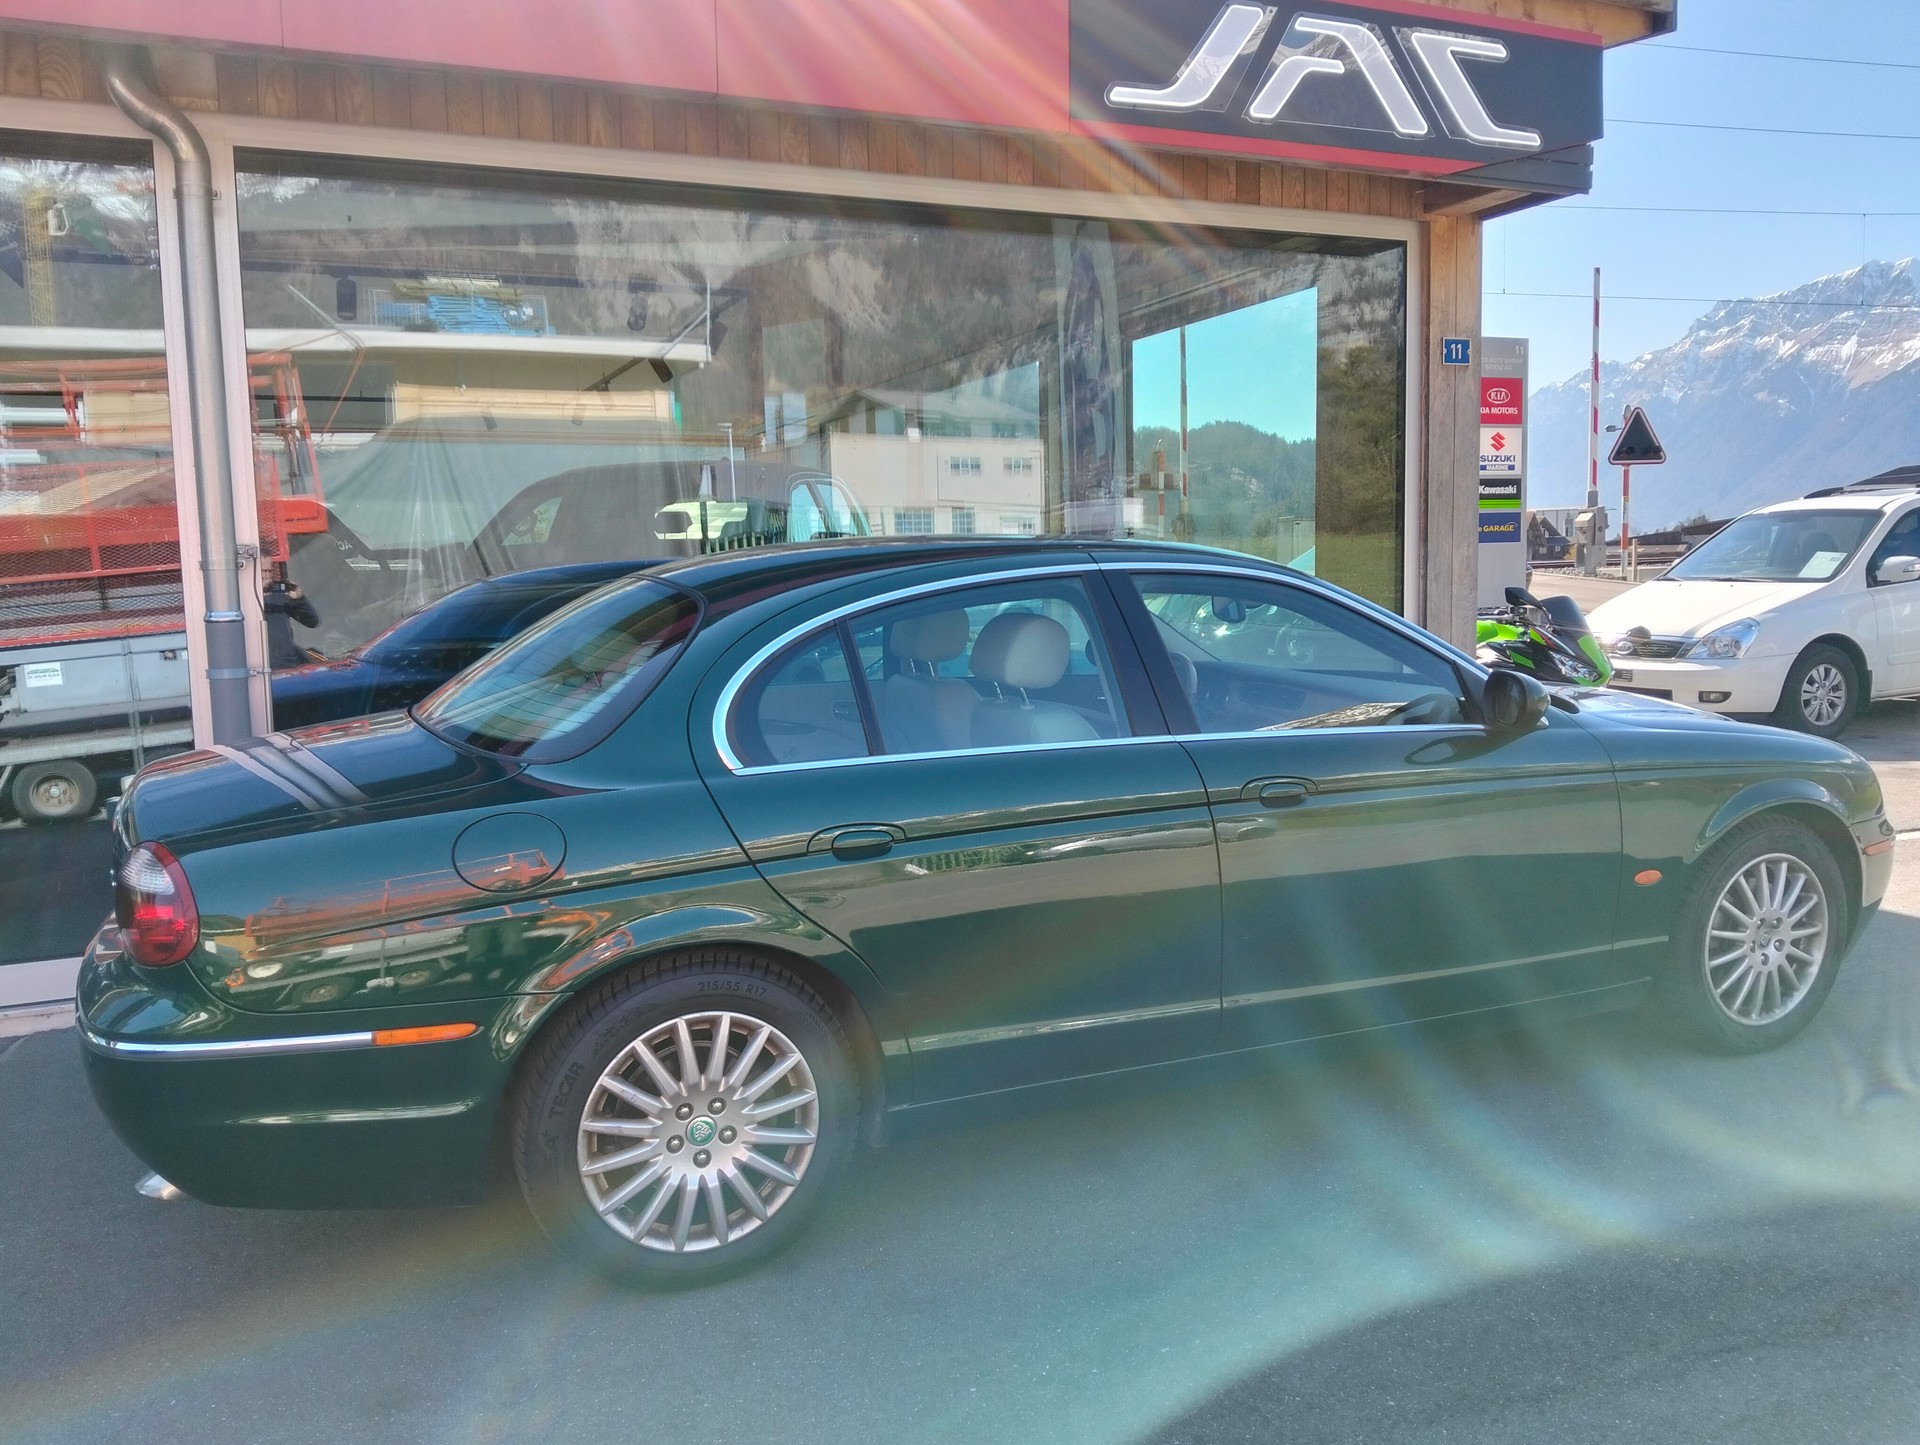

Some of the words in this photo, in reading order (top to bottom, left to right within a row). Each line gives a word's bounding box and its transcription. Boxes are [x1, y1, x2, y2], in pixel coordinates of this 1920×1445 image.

[1107, 3, 1543, 148] JAC
[1450, 343, 1462, 360] 11
[1515, 345, 1524, 355] 11
[1490, 391, 1507, 401] KIA
[1491, 406, 1518, 414] MOTORS
[1480, 454, 1515, 463] SUZUKI
[1479, 485, 1517, 494] Kawasaki
[1483, 524, 1516, 532] GARAGE
[698, 980, 740, 992] 215/55
[745, 983, 768, 996] R17
[547, 1061, 586, 1119] TECAR
